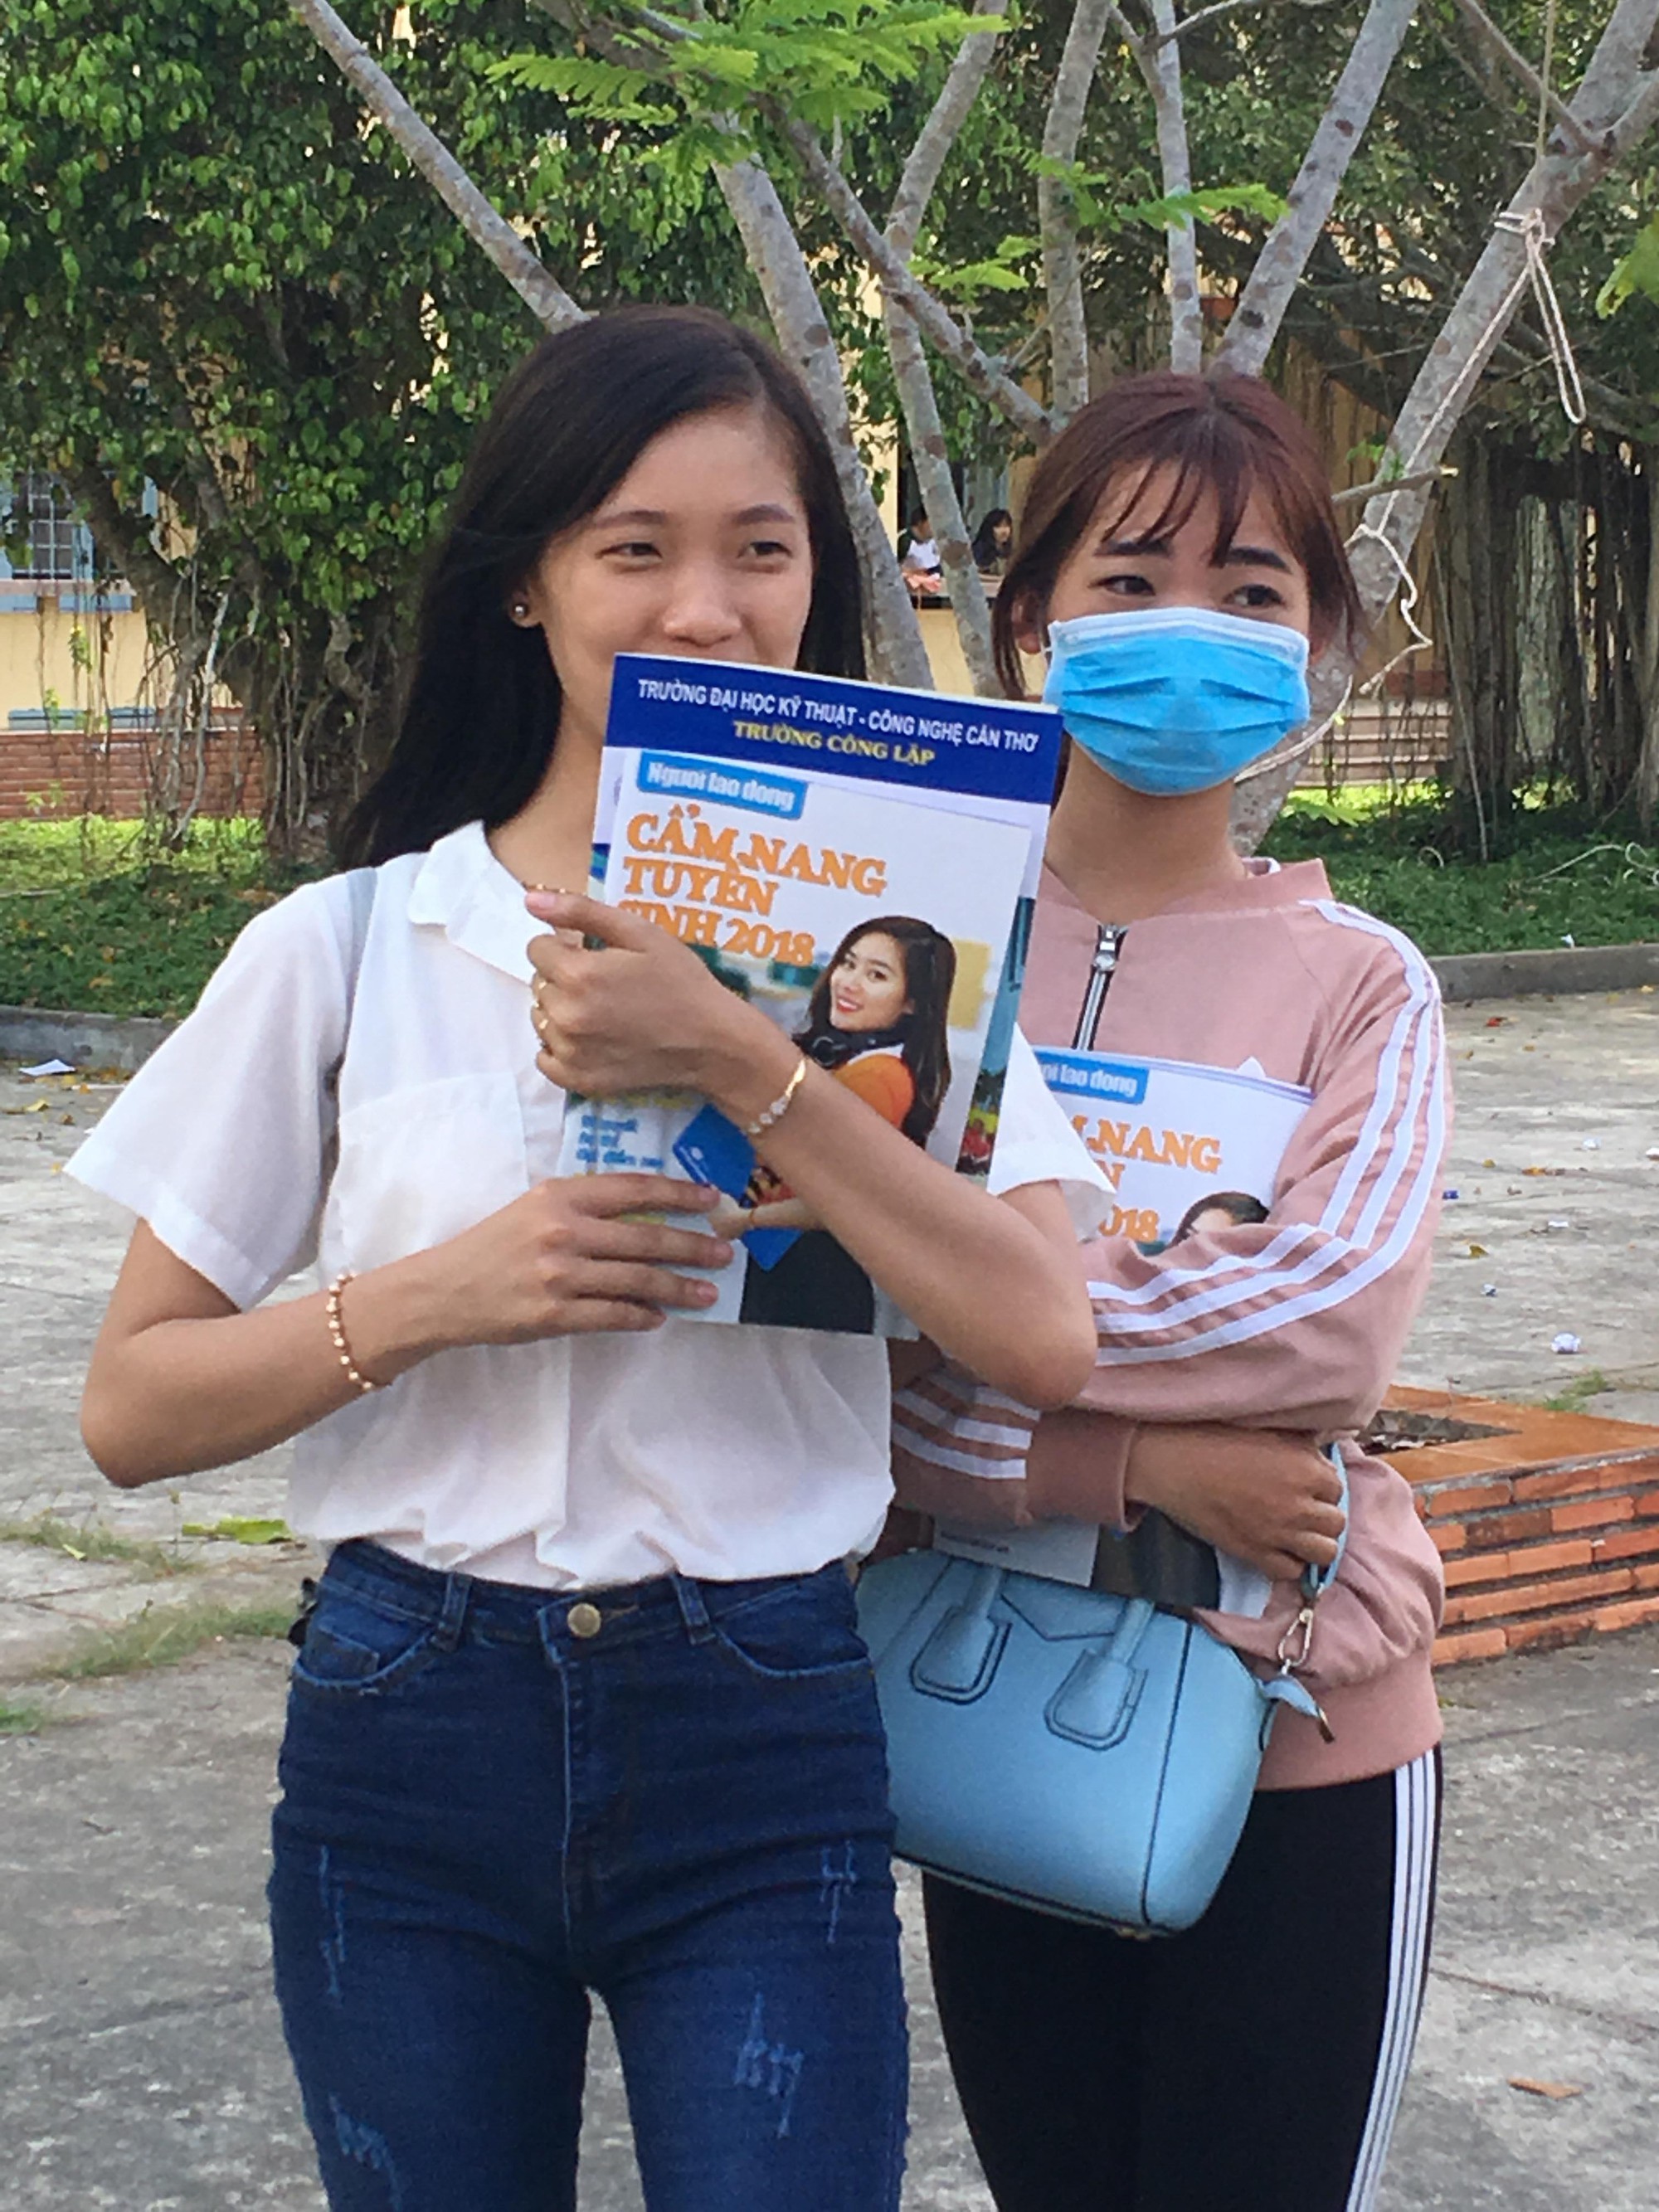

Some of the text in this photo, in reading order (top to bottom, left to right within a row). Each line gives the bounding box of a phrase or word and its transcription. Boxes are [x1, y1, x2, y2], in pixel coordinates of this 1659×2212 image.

[638, 678, 706, 705] TRƯỜNG
[710, 687, 737, 712] ĐẠI
[740, 692, 776, 716] HỌC
[805, 700, 857, 729] THUẬT
[868, 709, 915, 736] CÔNG
[917, 719, 962, 747] NGHỆ
[1004, 731, 1040, 753] THƠ
[827, 733, 888, 760] CÔNG
[747, 834, 888, 897] NANG
[722, 917, 815, 968] 2018
[1097, 1118, 1223, 1175] NANG
